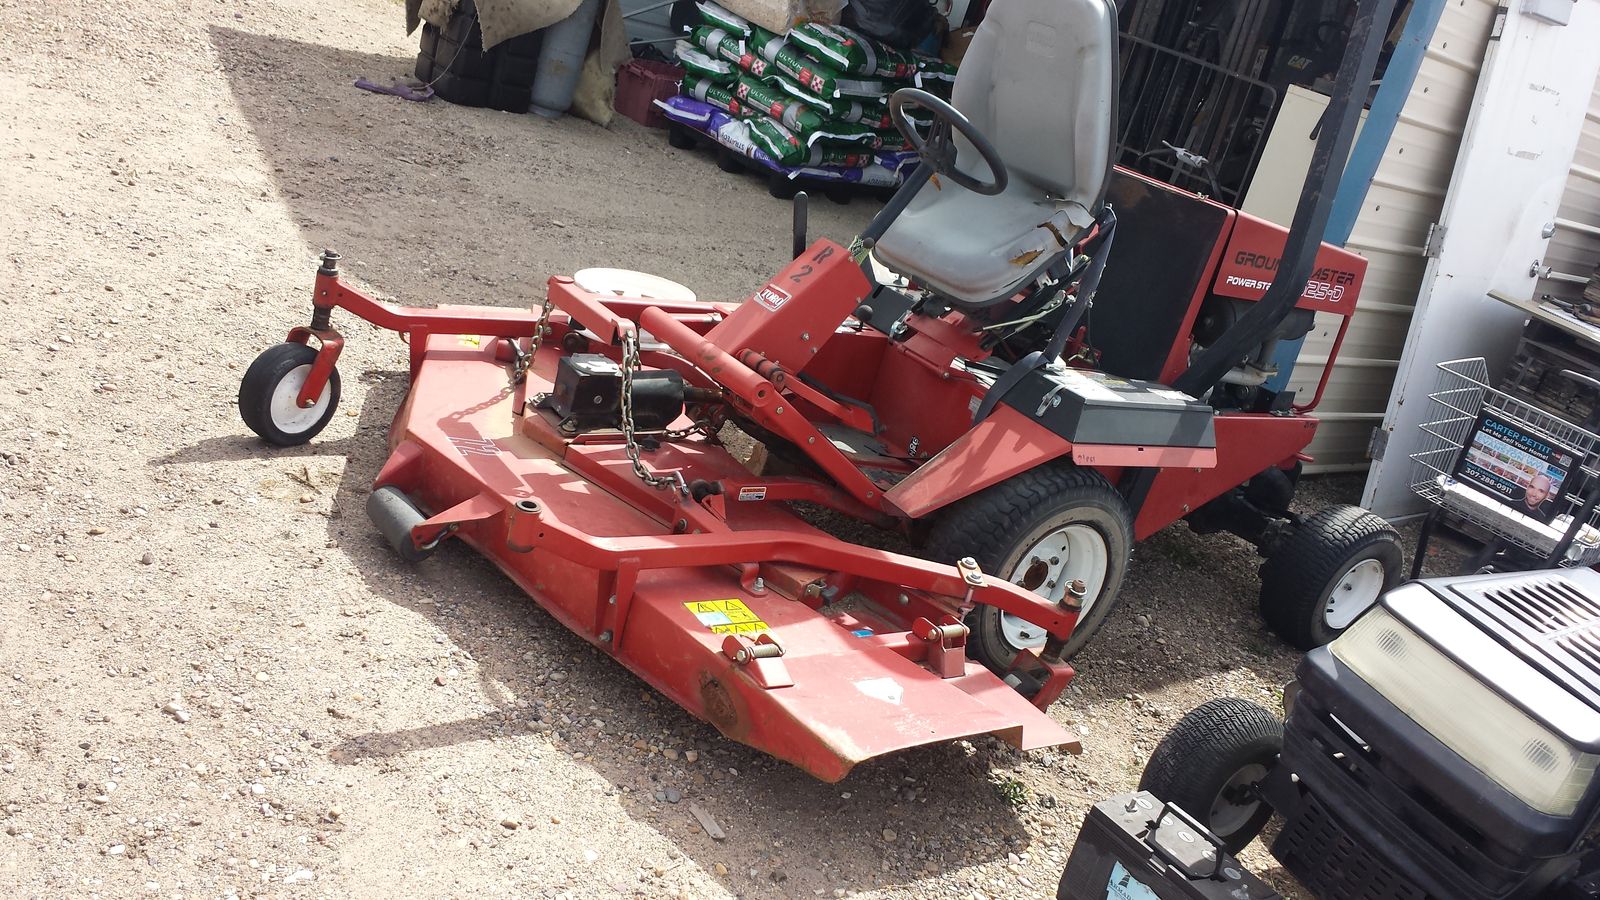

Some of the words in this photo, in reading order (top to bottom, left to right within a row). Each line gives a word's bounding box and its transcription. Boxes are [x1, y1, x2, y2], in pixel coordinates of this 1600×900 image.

[778, 51, 803, 71] ULTIUM
[1287, 55, 1313, 71] CAT
[708, 87, 733, 101] ULTIUM
[750, 87, 776, 104] ULTIUM
[1226, 275, 1257, 288] POWER
[1301, 279, 1345, 303] 25-D
[761, 287, 786, 306] TORO
[1482, 426, 1492, 434] Let
[1492, 430, 1502, 438] Me
[1503, 435, 1515, 444] Sell
[1514, 440, 1528, 450] Your
[1528, 446, 1549, 461] Home!
[1485, 418, 1521, 440] CARTER
[1520, 435, 1552, 454] PETTIT
[1465, 467, 1513, 494] 307-288-0911
